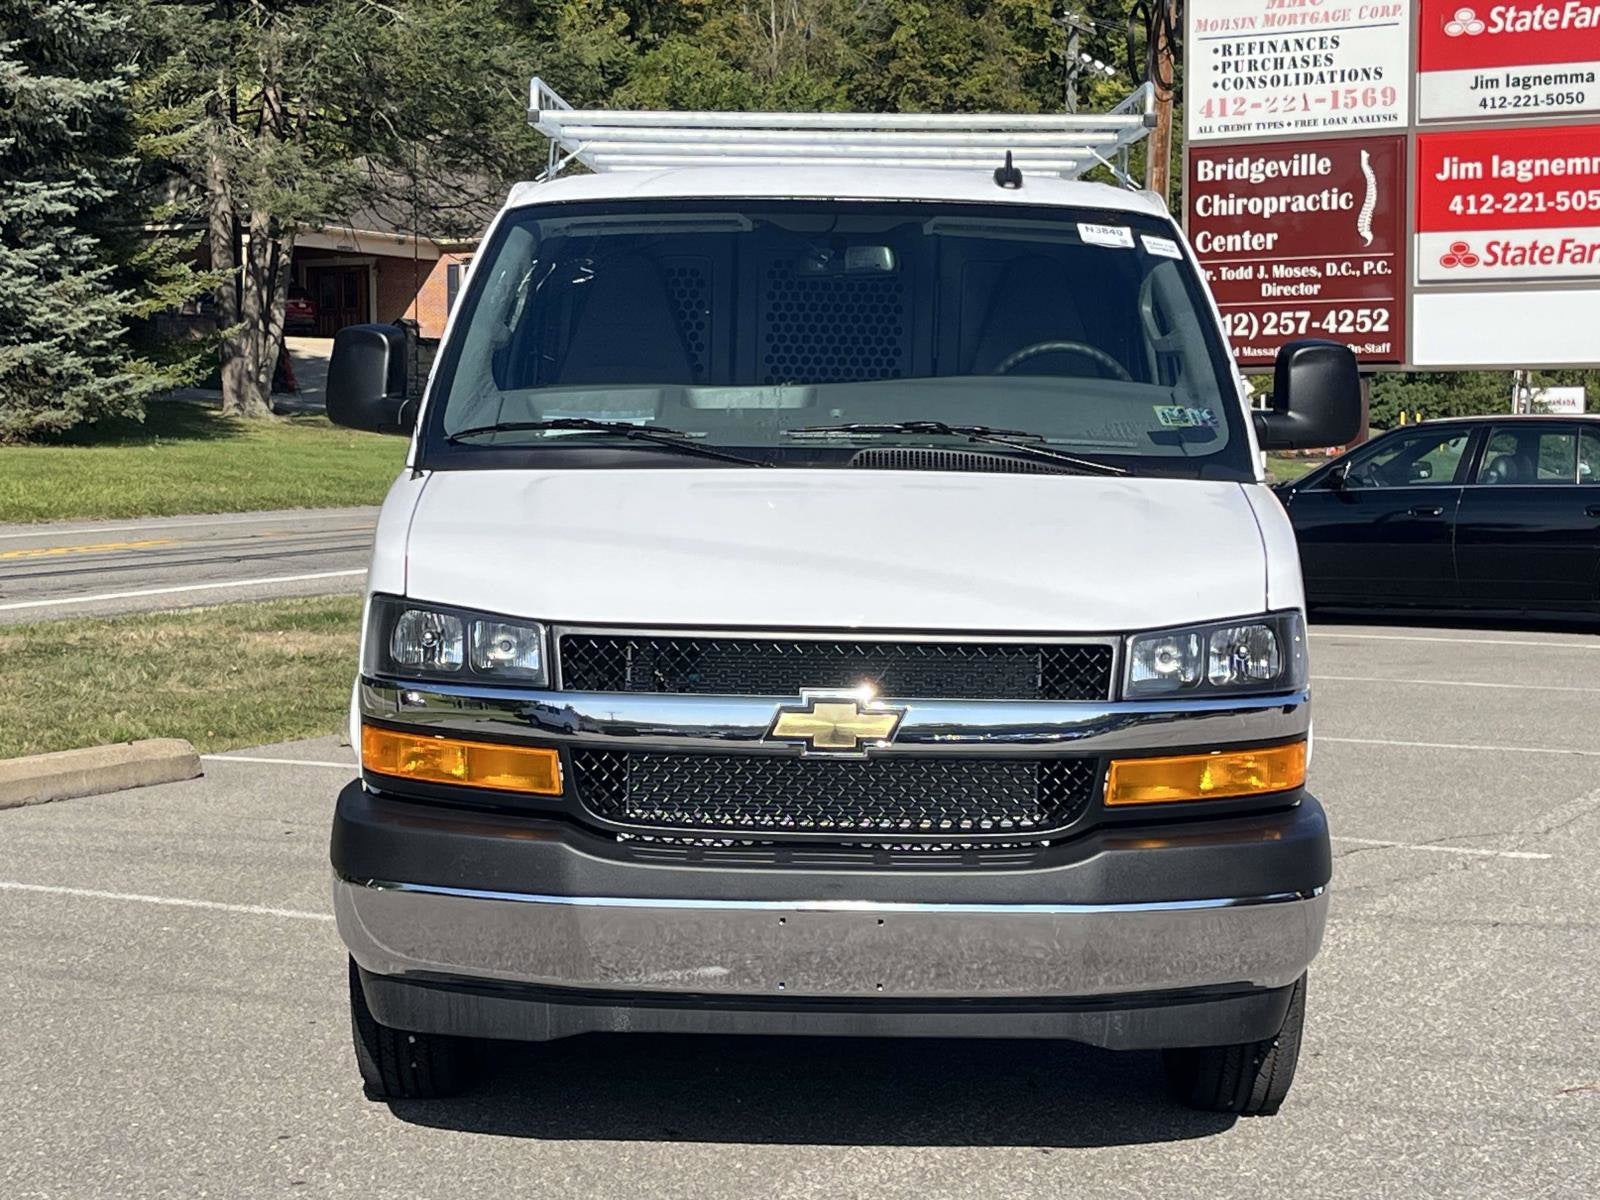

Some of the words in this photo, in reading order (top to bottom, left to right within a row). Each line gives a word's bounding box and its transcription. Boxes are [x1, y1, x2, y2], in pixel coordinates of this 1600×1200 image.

[1261, 8, 1351, 29] MORTGAGE
[1487, 1, 1600, 34] StateFar
[1221, 35, 1341, 57] REFINANCES
[1221, 52, 1334, 74] PURCHASES
[1221, 66, 1384, 92] CONSOLIDATIONS
[1470, 75, 1500, 90] Jim
[1198, 86, 1397, 119] 412-221-1569
[1479, 91, 1585, 110] 412-221-5050
[1197, 125, 1215, 135] ALL
[1218, 122, 1252, 133] CREDIT
[1256, 120, 1284, 131] TYPES
[1294, 118, 1319, 128] FREE
[1322, 116, 1348, 126] LOAN
[1351, 113, 1398, 125] ANALYSIS
[1197, 153, 1332, 184] Bridgeville
[1435, 156, 1483, 181] Jim
[1195, 187, 1353, 219] Chiropractic
[1448, 189, 1600, 215] 412-221-505
[1195, 231, 1278, 253] Center
[1483, 238, 1600, 267] StateFar
[1219, 266, 1253, 281] Todd
[1256, 265, 1269, 279] J.
[1272, 264, 1322, 280] Moses,
[1363, 260, 1392, 275] P.C.
[1261, 283, 1321, 297] Director
